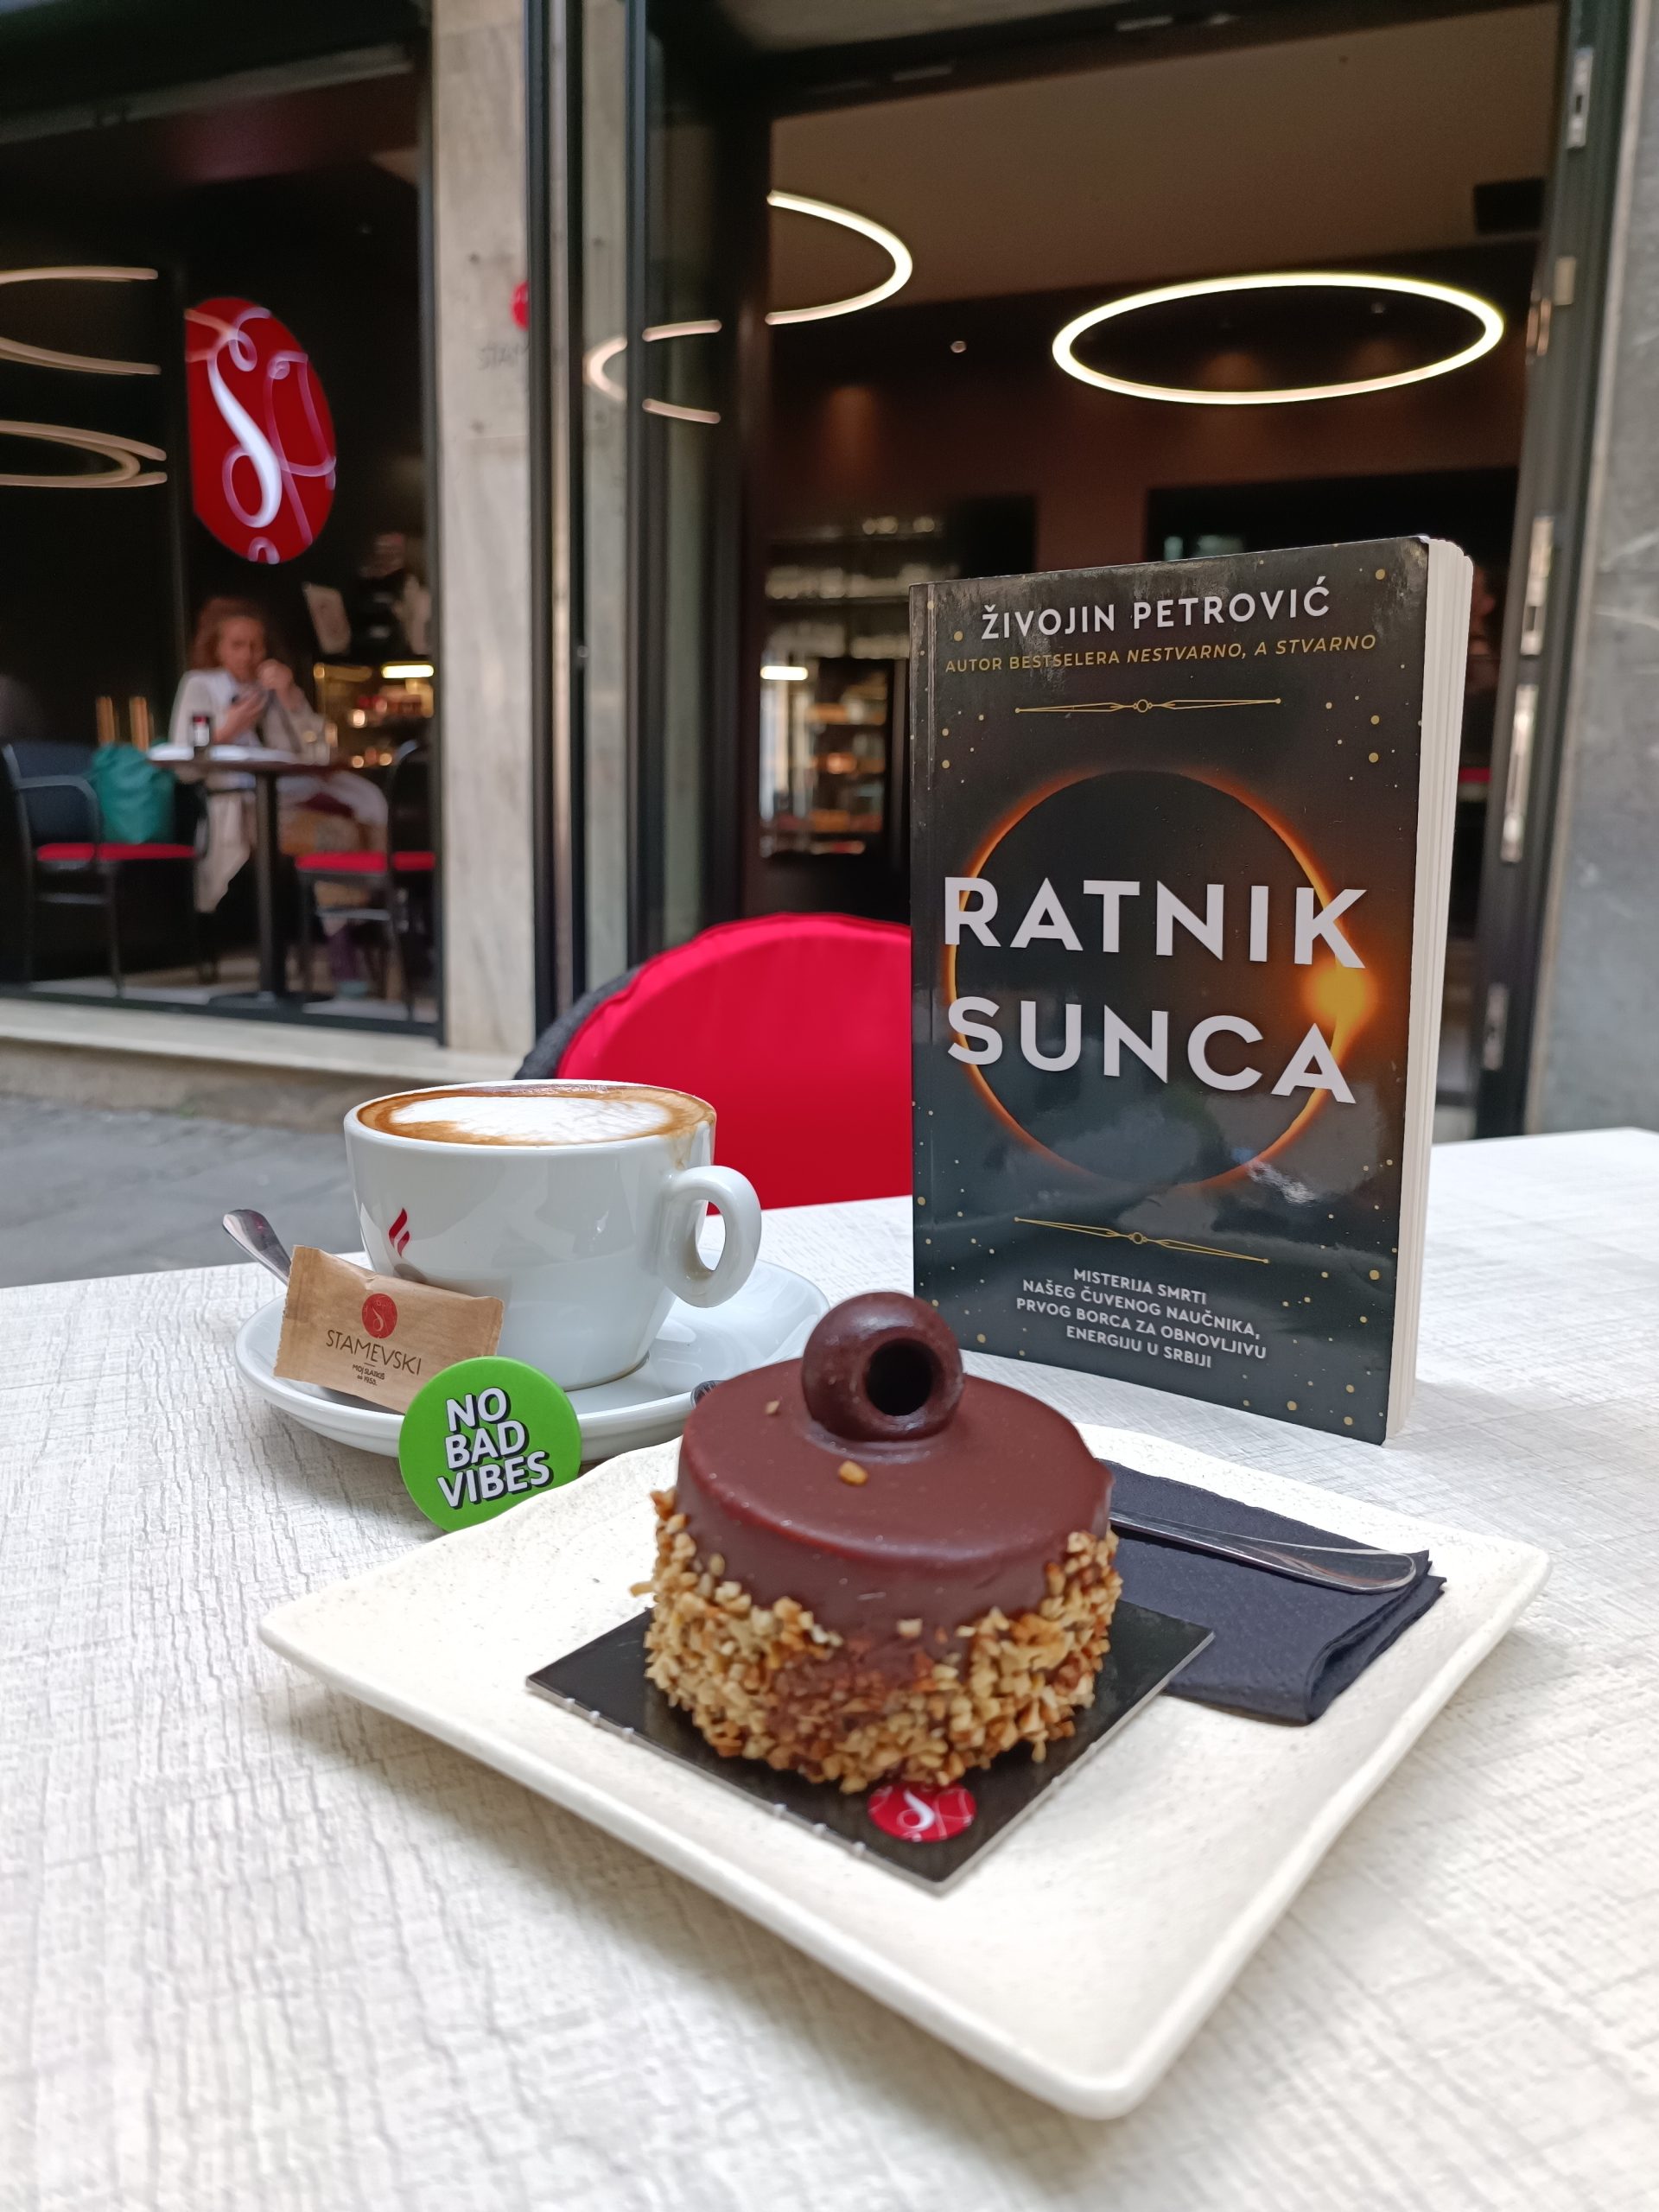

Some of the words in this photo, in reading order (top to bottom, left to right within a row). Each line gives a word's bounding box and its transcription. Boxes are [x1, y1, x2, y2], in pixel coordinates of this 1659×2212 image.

[981, 604, 1115, 640] ŽIVOJIN
[1133, 575, 1331, 631] PETROVIĆ
[944, 657, 1002, 673] AUTOR
[1009, 650, 1121, 670] BESTSELERA
[1127, 643, 1247, 664] NESTVARNO,
[1254, 641, 1268, 656] A
[1275, 634, 1376, 655] STVARNO
[944, 876, 1368, 969] RATNIK
[947, 996, 1357, 1104] SUNCA
[1022, 1279, 1076, 1300] NAŠEG
[1080, 1285, 1162, 1317] ČUVENOG
[1166, 1306, 1261, 1340] NAUČNIKA,
[1073, 1268, 1154, 1294] MISTERIJA
[1157, 1283, 1207, 1306] SMRTI
[326, 1330, 422, 1376] STAMEVSKI
[1016, 1297, 1071, 1319] PRVOG
[1076, 1307, 1132, 1331] BORCA
[1135, 1319, 1156, 1336] ZA
[1160, 1325, 1267, 1359] OBNOVLJIVU
[1066, 1325, 1143, 1352] ENERGIJU
[1147, 1342, 1159, 1356] U
[1163, 1345, 1212, 1369] SRBIJI
[446, 1387, 512, 1433] NO
[445, 1420, 530, 1471] BAD
[436, 1449, 554, 1510] VIBES
